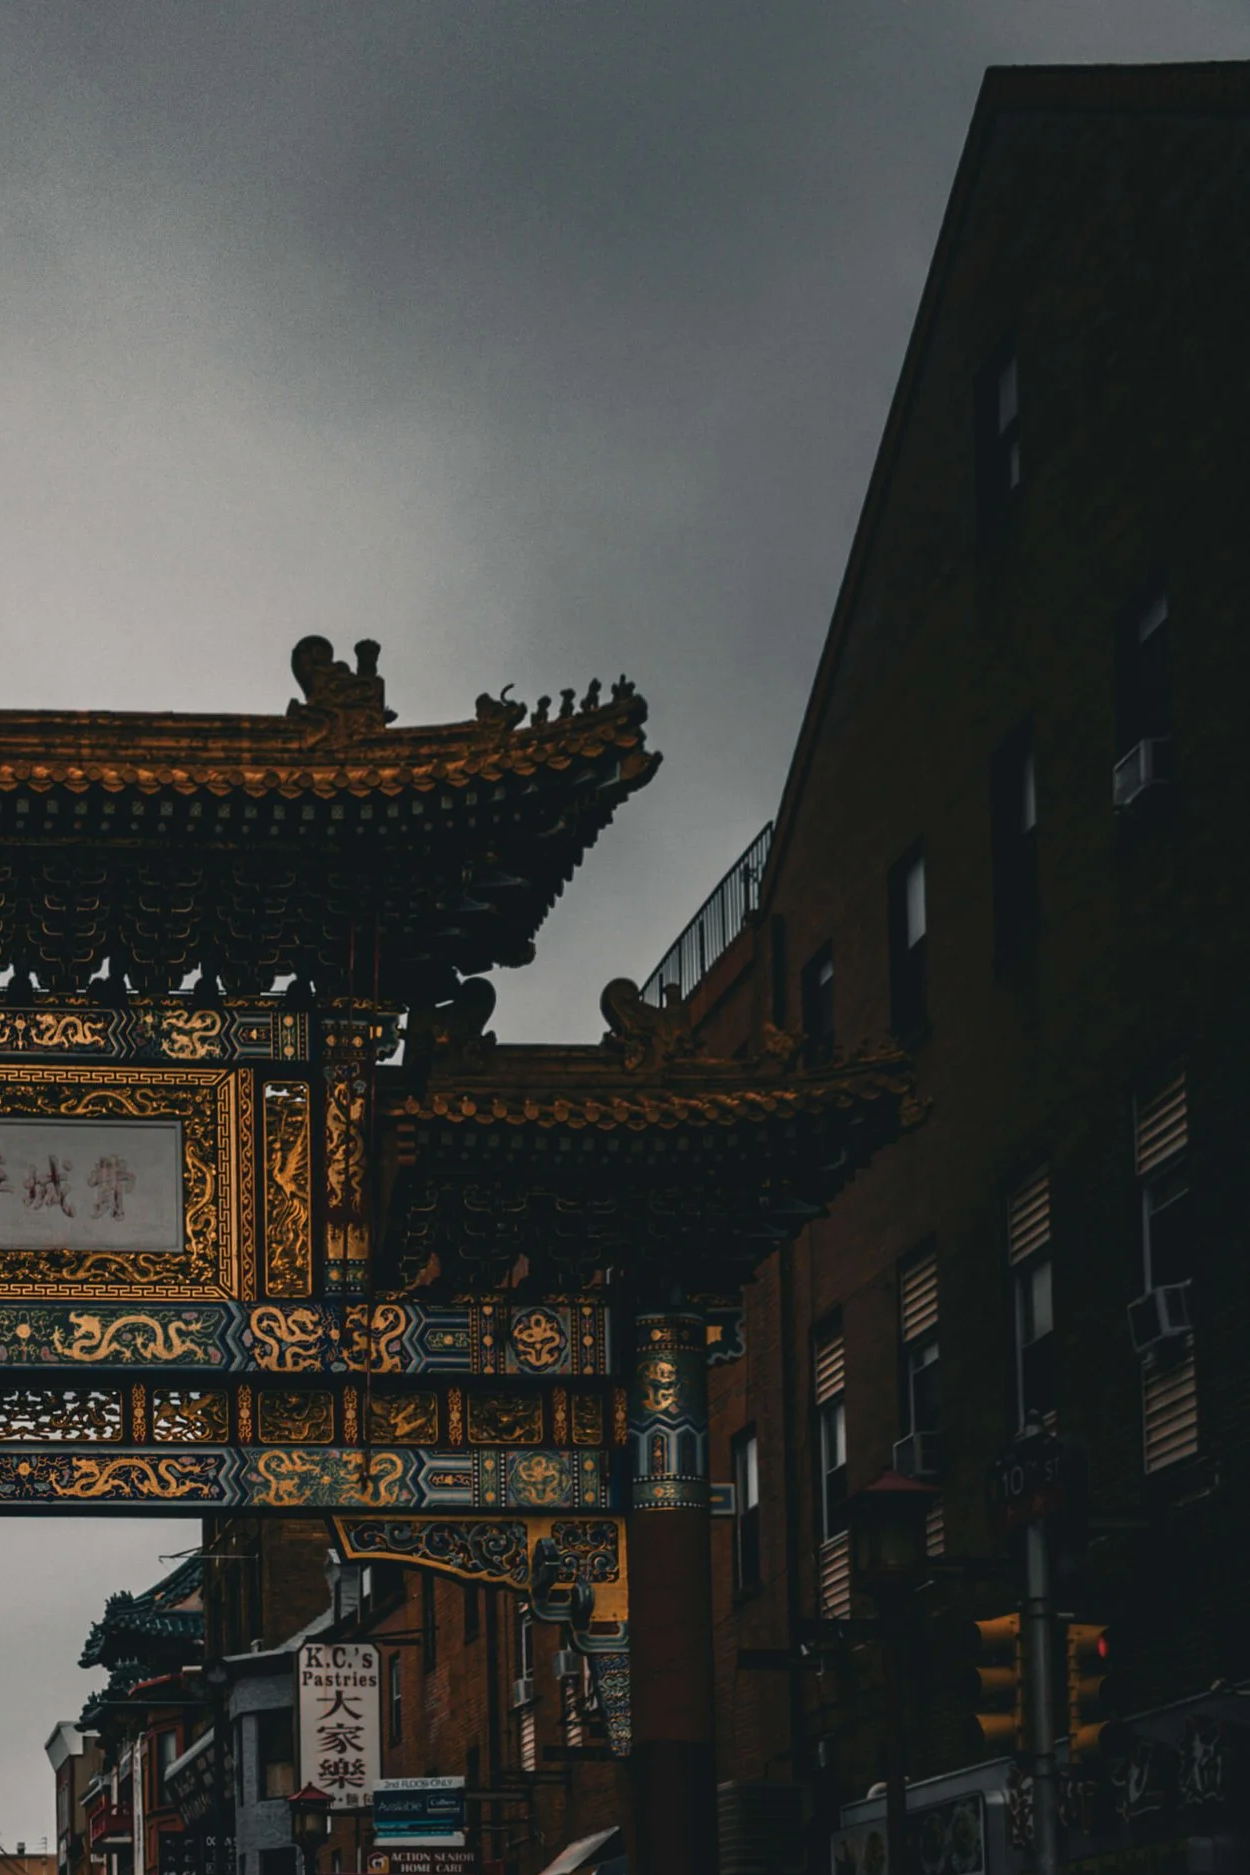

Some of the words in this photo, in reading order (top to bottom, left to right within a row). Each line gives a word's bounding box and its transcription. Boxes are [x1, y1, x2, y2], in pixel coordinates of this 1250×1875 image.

[305, 1647, 373, 1669] K.C.'s
[302, 1671, 377, 1687] Pastries
[315, 1689, 367, 1789] 大家樂
[390, 1852, 432, 1863] ACTION
[434, 1852, 475, 1863] SENIOR
[400, 1863, 432, 1873] HOME
[435, 1863, 464, 1873] CARE
